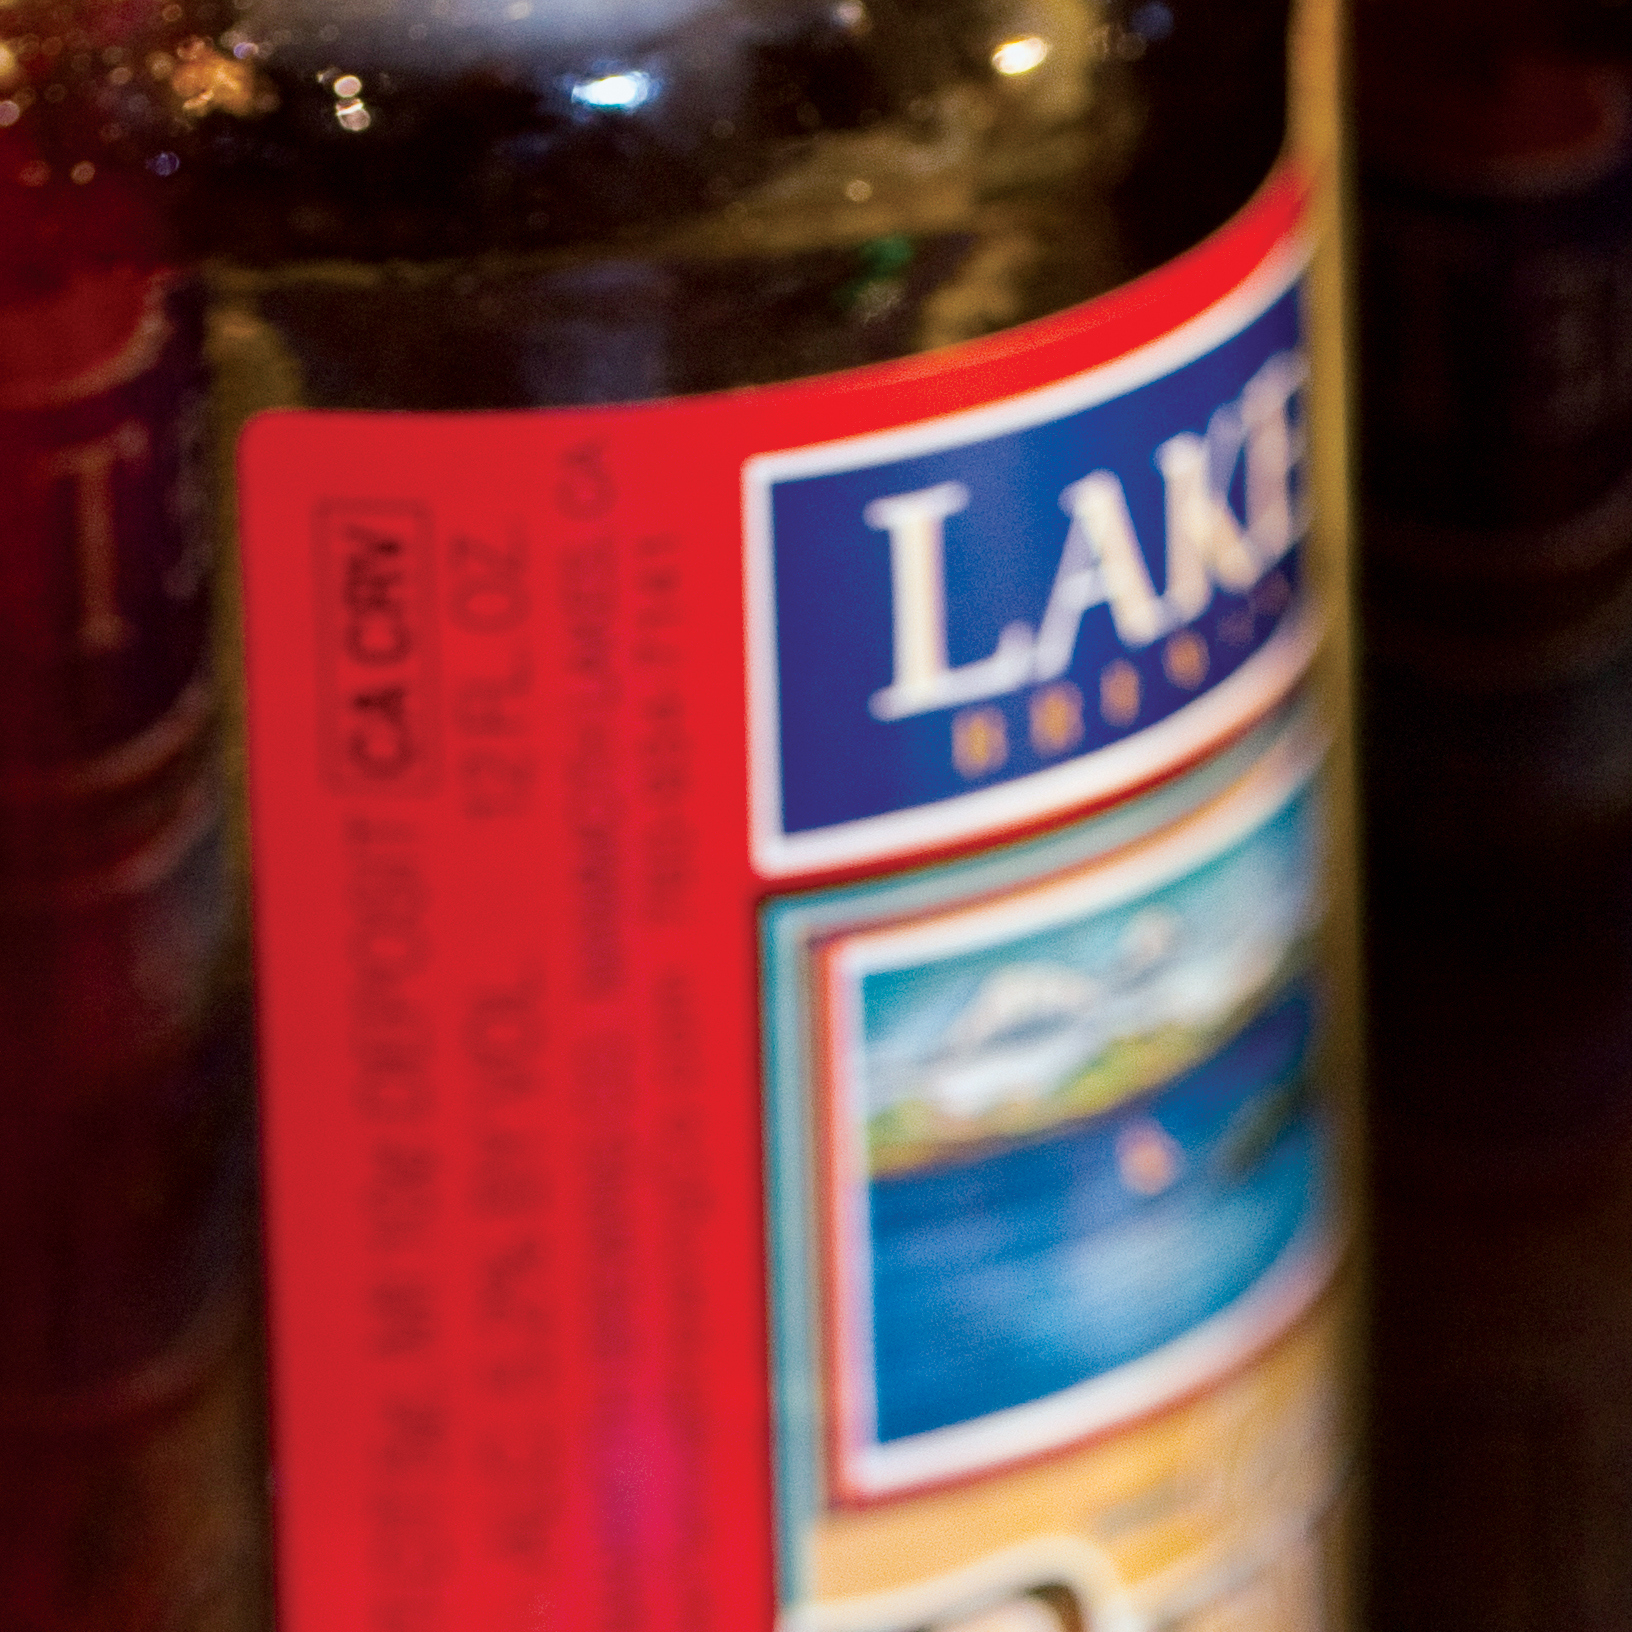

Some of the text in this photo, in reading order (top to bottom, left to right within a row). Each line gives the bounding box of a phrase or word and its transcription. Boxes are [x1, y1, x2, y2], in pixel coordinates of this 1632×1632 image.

[338, 520, 415, 780] CA CRV
[458, 749, 536, 820] 12
